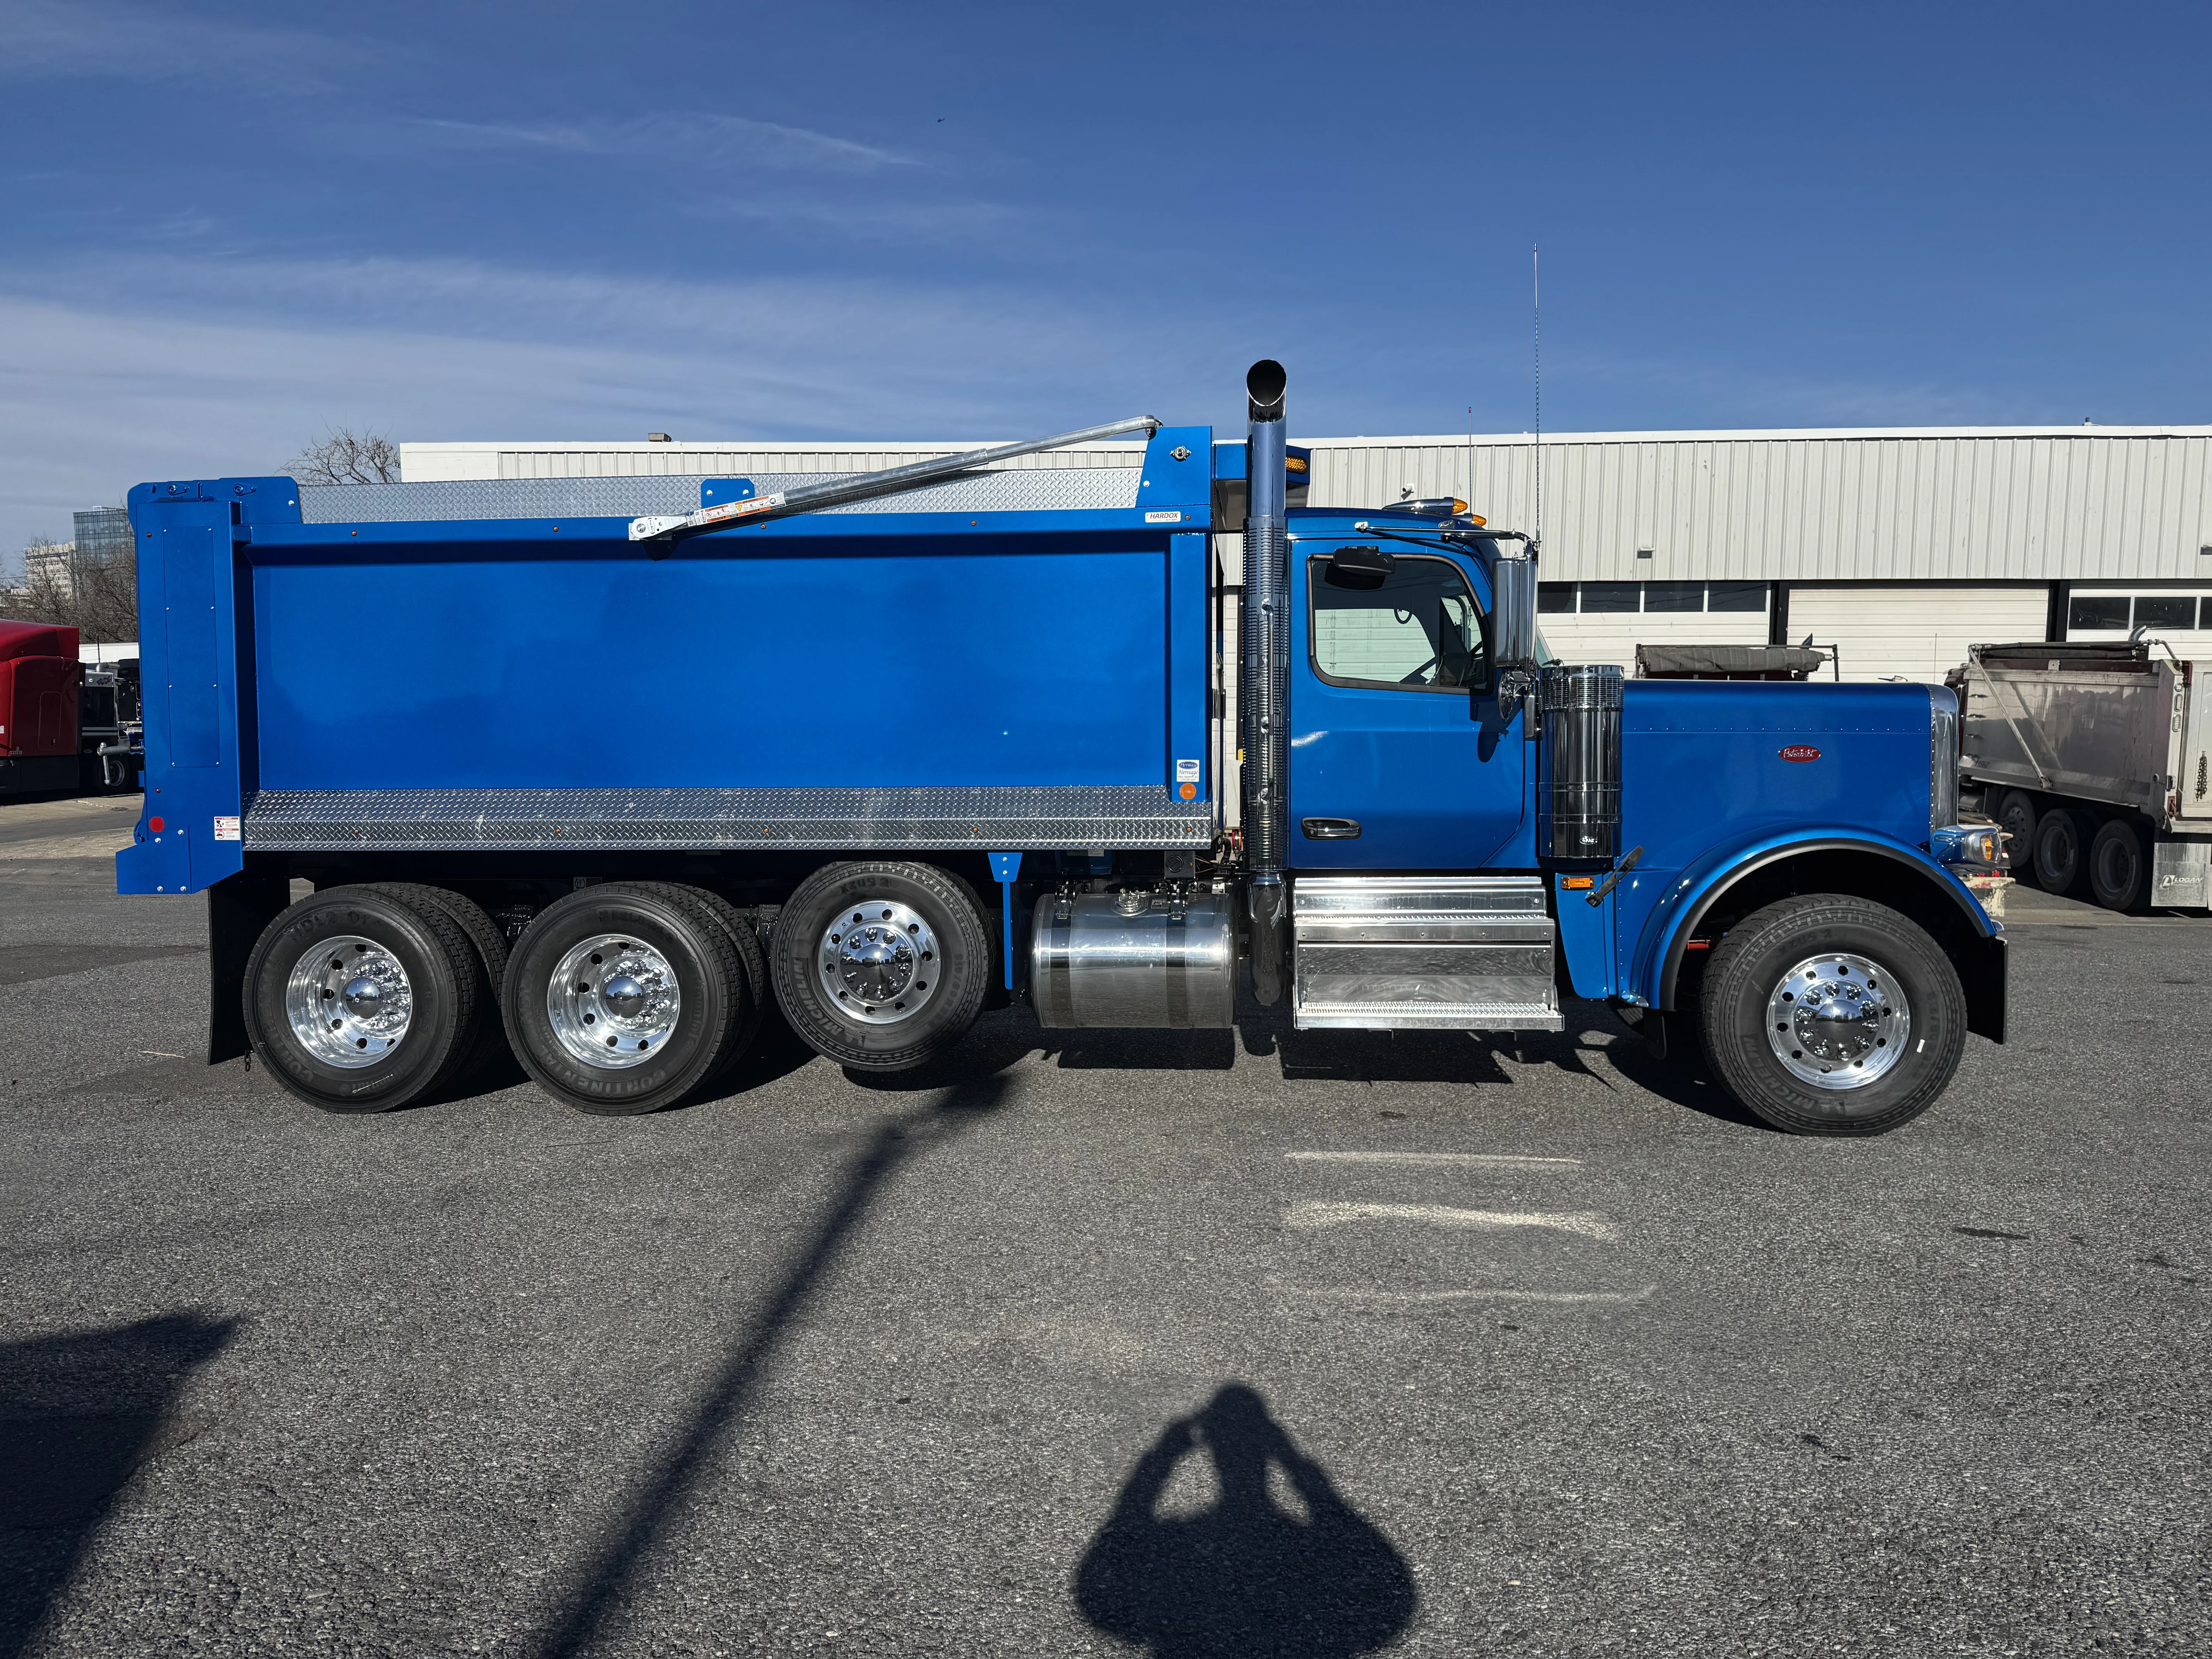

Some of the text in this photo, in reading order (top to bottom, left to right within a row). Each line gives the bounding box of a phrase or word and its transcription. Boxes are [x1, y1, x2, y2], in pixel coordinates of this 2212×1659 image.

[1178, 769, 1198, 777] Heritage
[1783, 748, 1817, 758] Peterbilt
[793, 958, 843, 1036] MICHELIN
[534, 1043, 667, 1097] CONTINENTAL
[1743, 1037, 1815, 1109] MICHELIN
